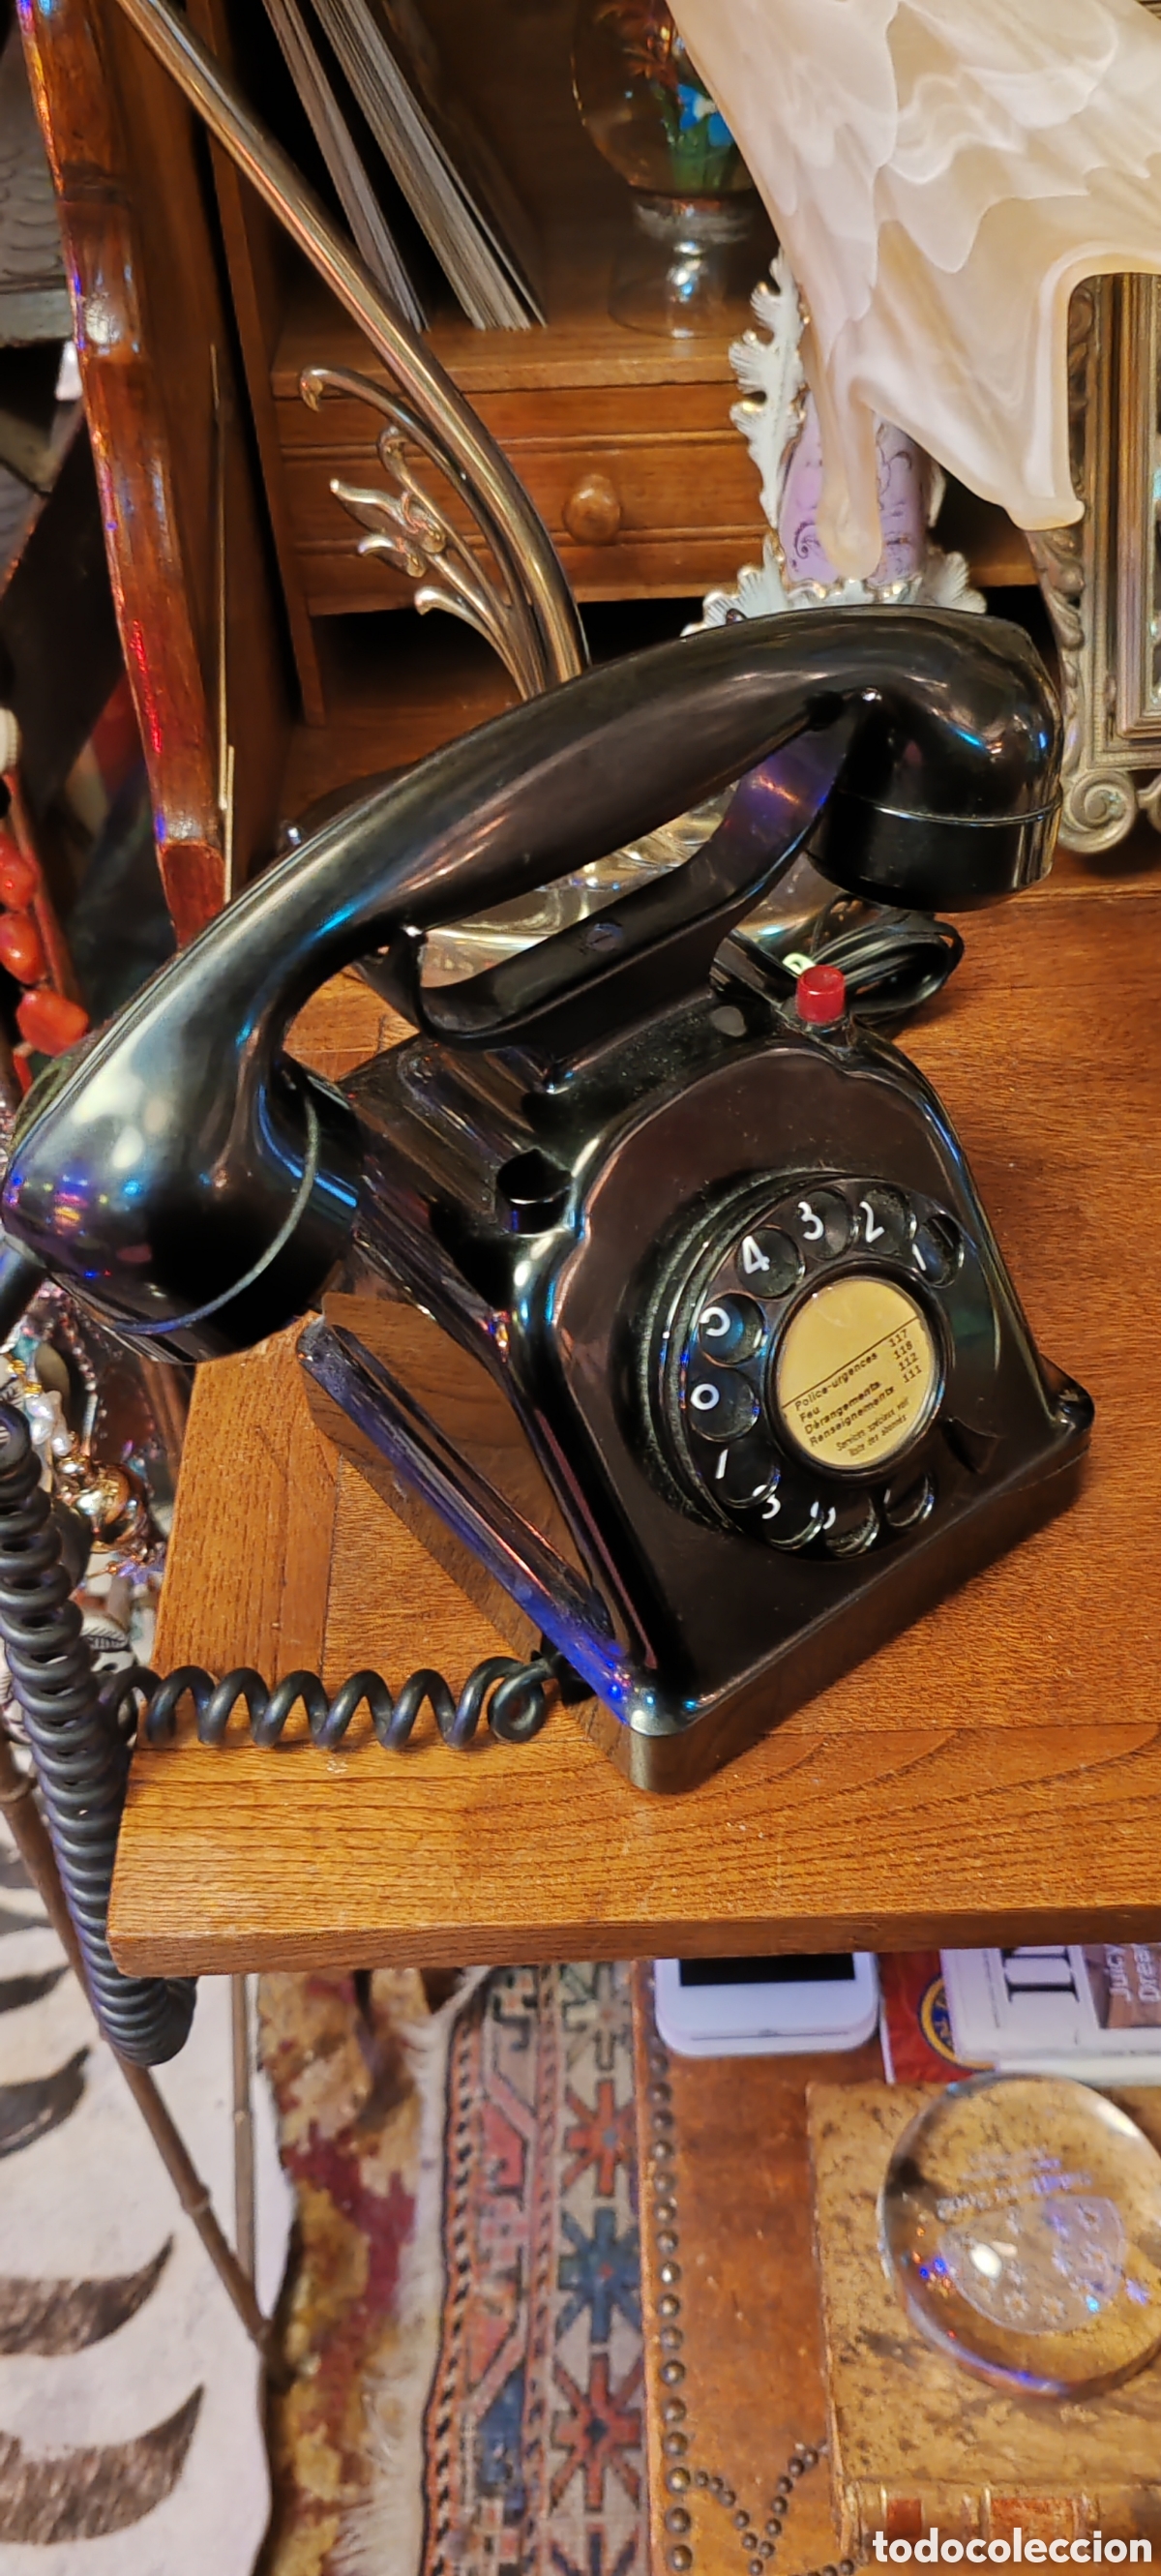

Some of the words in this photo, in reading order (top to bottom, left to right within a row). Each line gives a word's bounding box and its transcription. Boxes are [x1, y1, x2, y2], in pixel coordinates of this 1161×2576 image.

[797, 1201, 824, 1241] 3
[859, 1200, 885, 1243] 2
[741, 1235, 770, 1274] 4
[794, 1352, 878, 1412] Police-urgences
[888, 1329, 909, 1349] 117
[799, 1406, 820, 1423] Feu
[893, 1340, 913, 1361] 118
[898, 1352, 919, 1372] 112
[809, 1386, 896, 1448] Renseignements
[903, 1364, 923, 1384] 111
